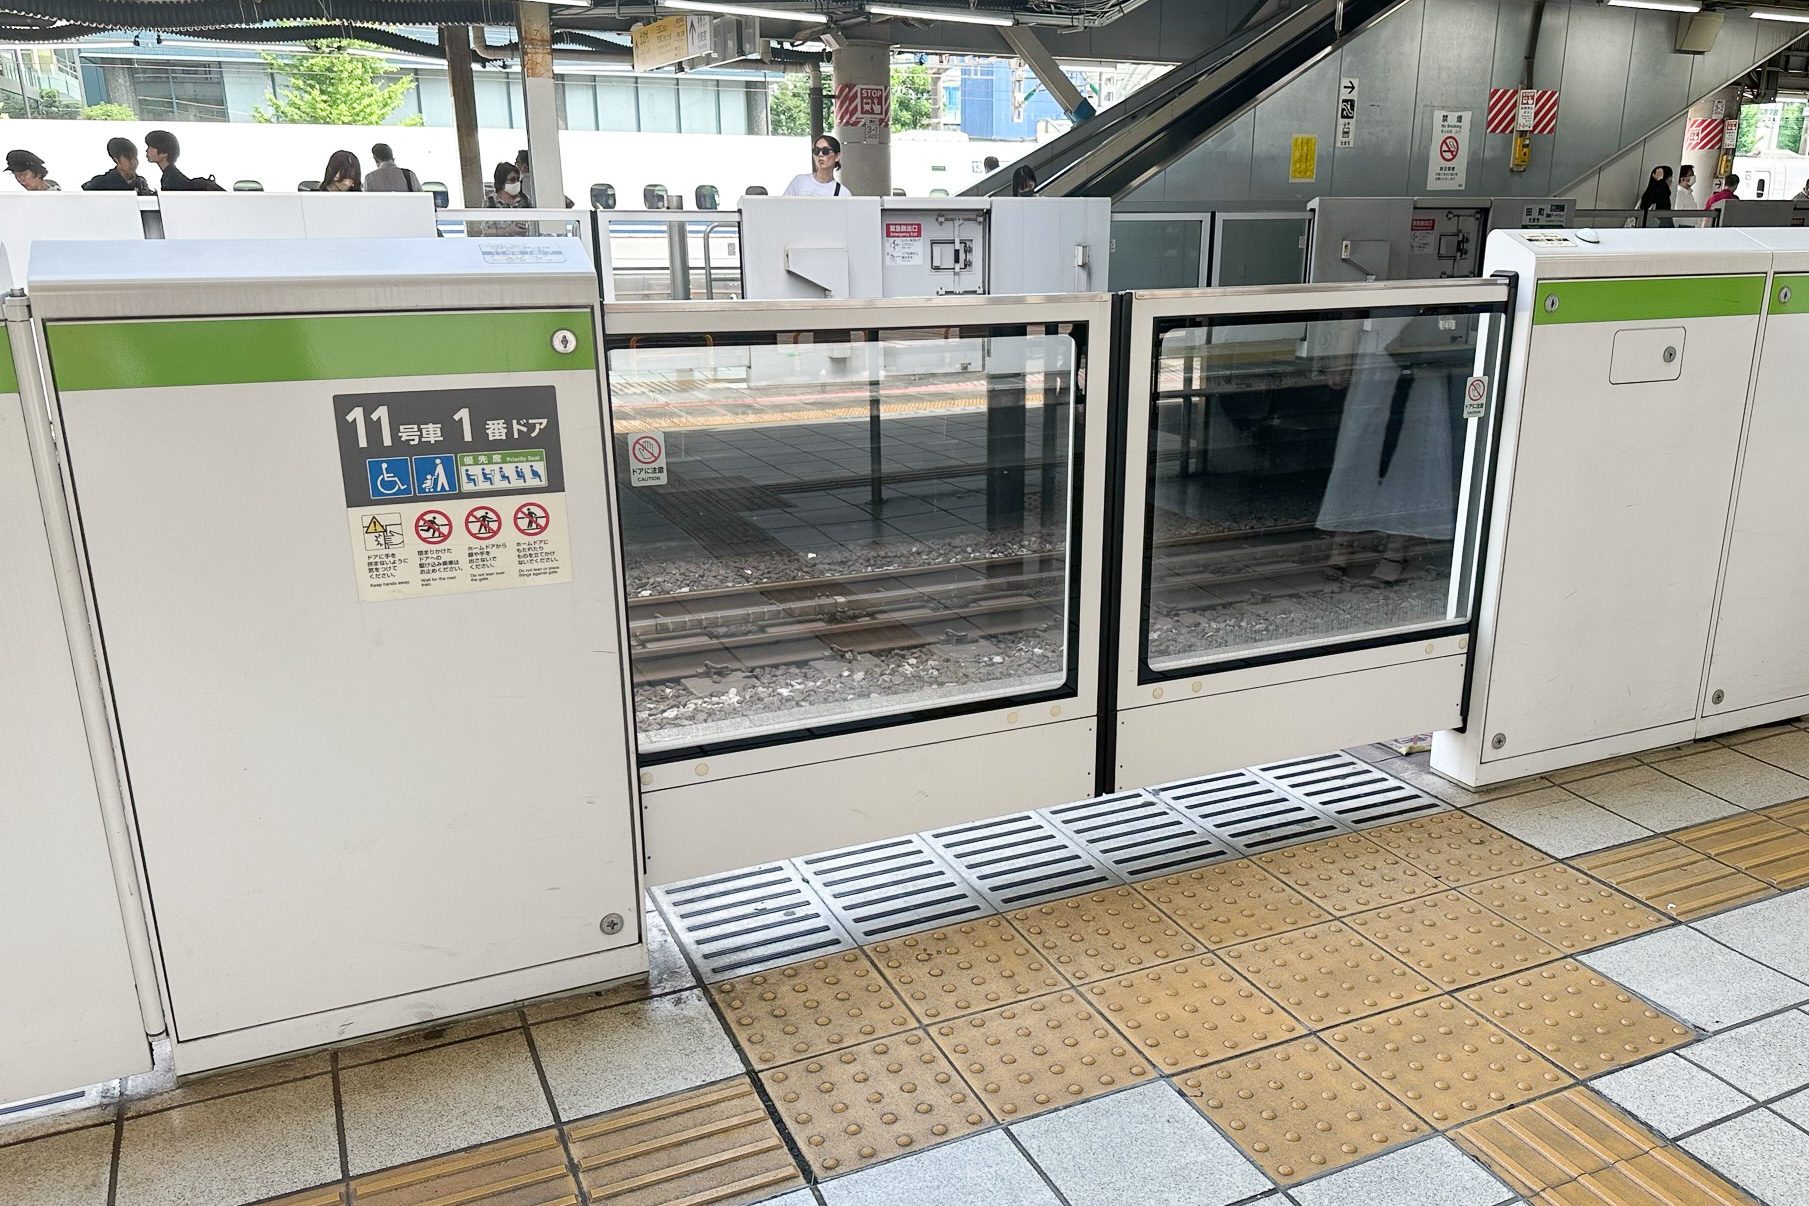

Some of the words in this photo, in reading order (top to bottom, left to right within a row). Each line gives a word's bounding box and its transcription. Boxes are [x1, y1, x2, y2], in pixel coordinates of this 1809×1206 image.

[867, 126, 878, 134] 3-1
[1526, 208, 1545, 216] 田町
[345, 405, 444, 448] 11号車
[453, 407, 548, 442] 1番ドア
[464, 454, 502, 464] 優先席
[632, 467, 664, 475] ドアに注意
[468, 543, 507, 551] ホームドアから
[517, 551, 555, 559] ものを立てかけ
[367, 558, 409, 567] 挟まないように
